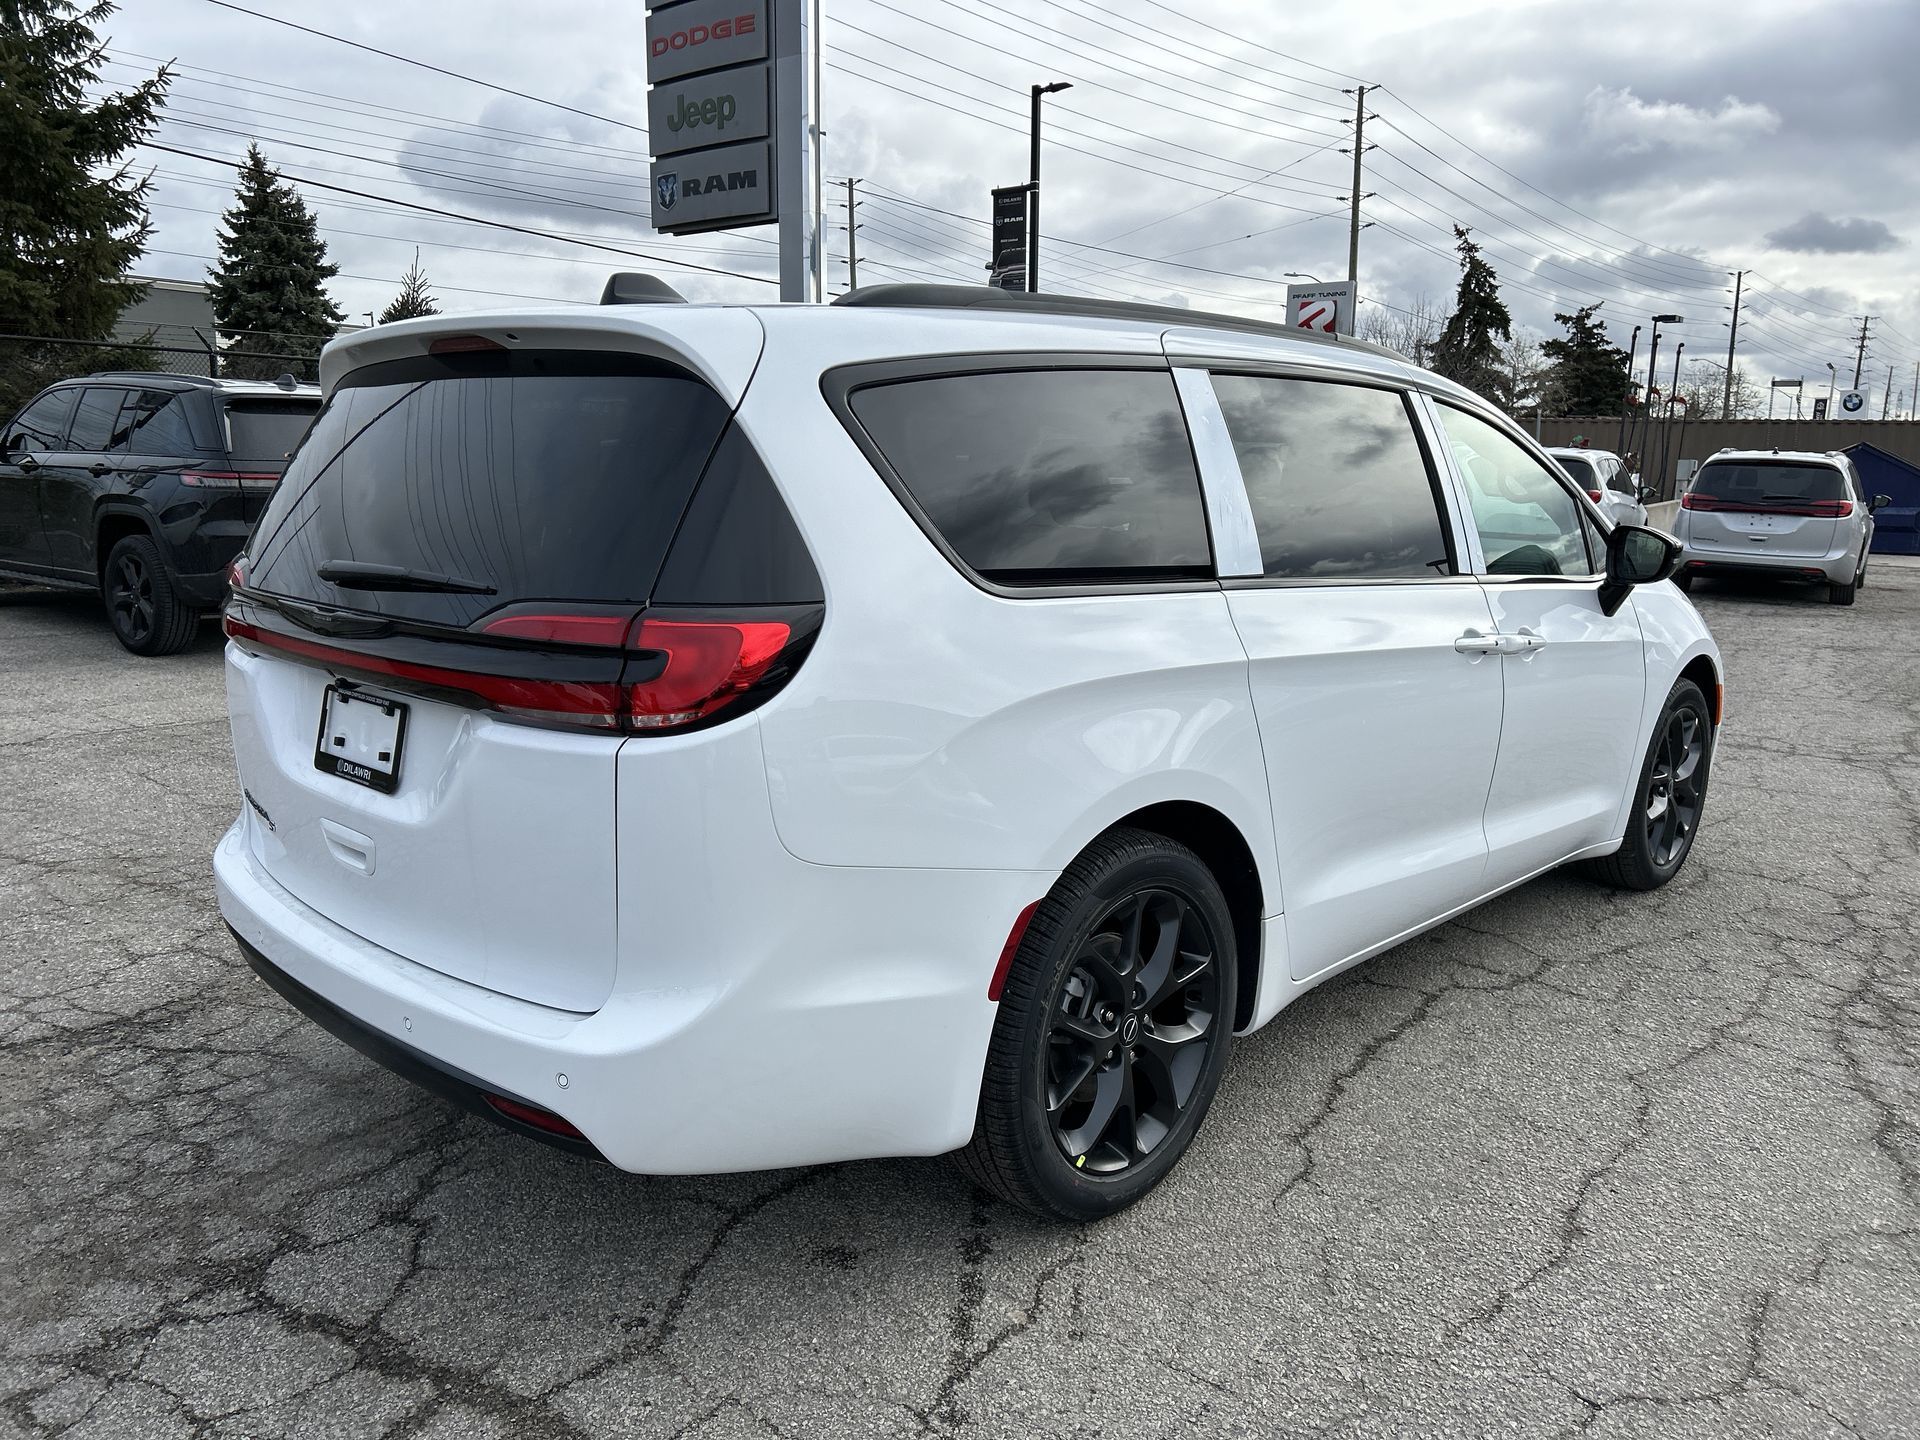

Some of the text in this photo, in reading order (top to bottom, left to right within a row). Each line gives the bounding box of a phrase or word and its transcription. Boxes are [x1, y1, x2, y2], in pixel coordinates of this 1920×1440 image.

[652, 14, 756, 58] DODGE
[667, 94, 736, 132] Jeep
[682, 169, 758, 198] RAM
[343, 762, 371, 781] DILAWRI
